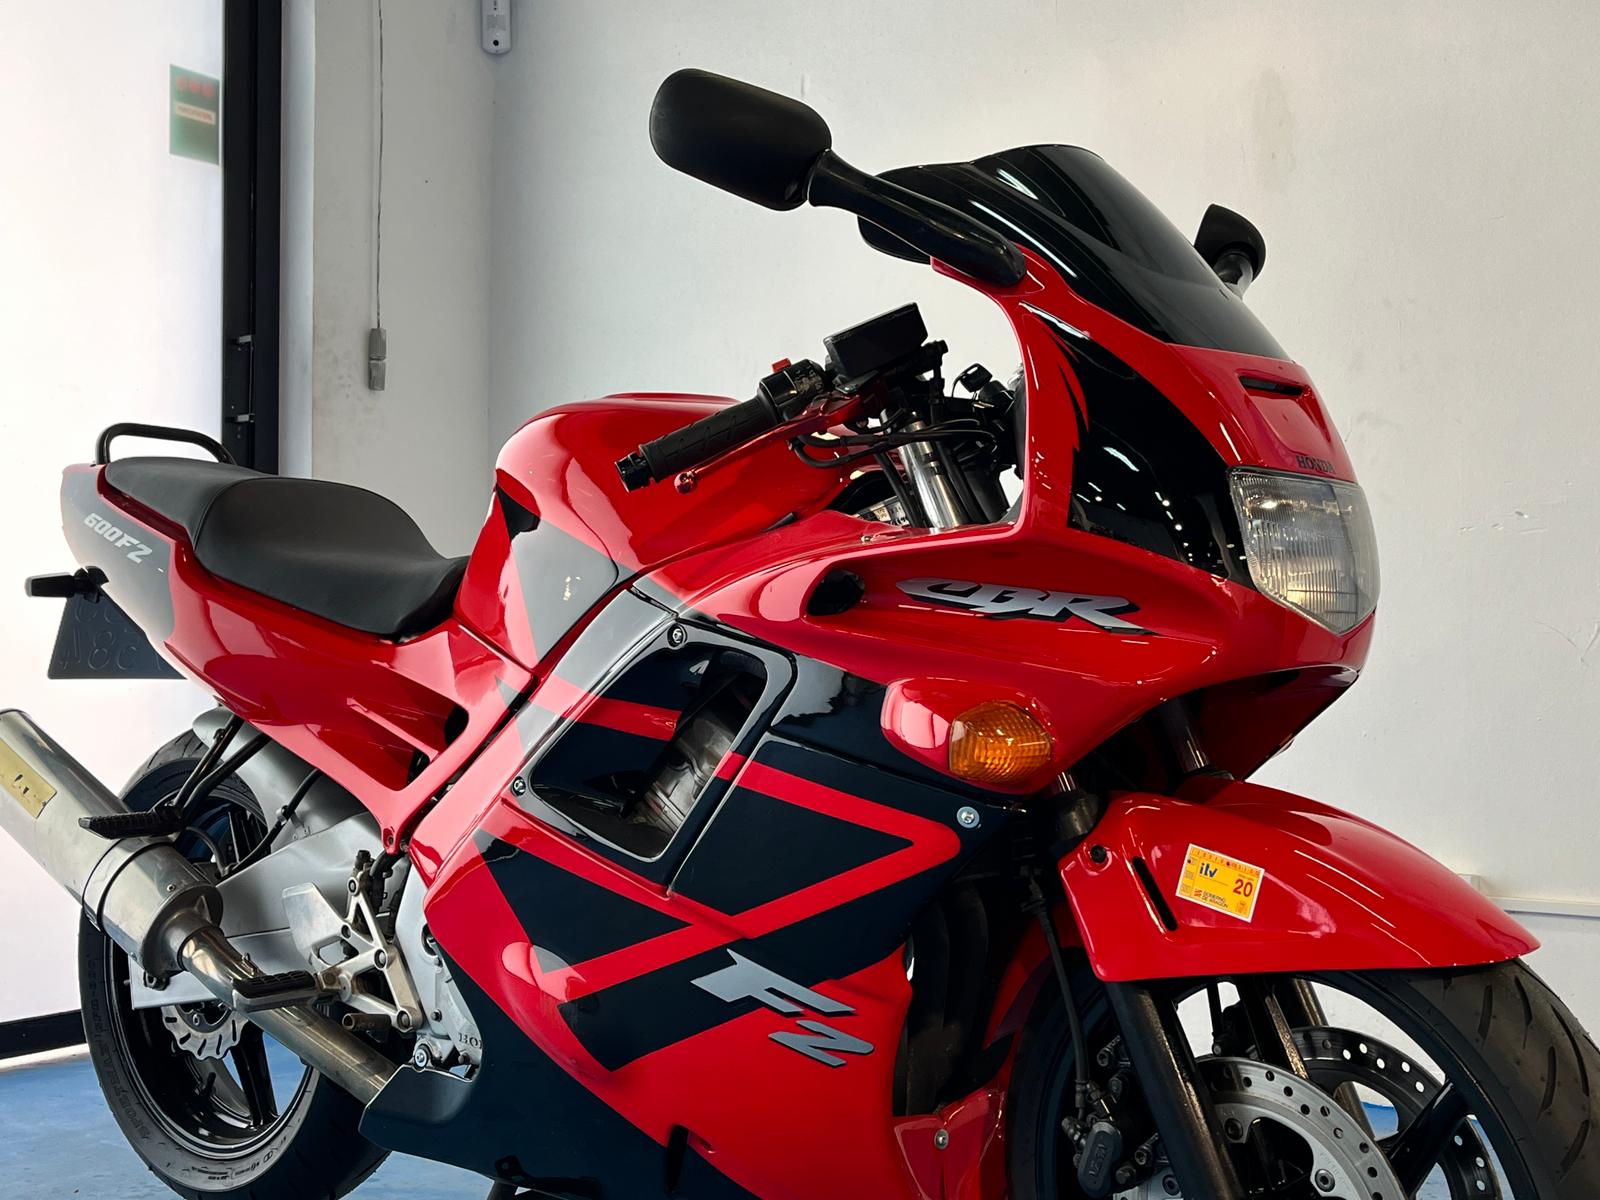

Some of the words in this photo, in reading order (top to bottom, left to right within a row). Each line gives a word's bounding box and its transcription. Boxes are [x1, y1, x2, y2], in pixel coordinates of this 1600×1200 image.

[1295, 454, 1336, 474] HONDA
[83, 513, 153, 564] 600F2
[895, 576, 1150, 634] CBR
[1233, 878, 1254, 898] 20
